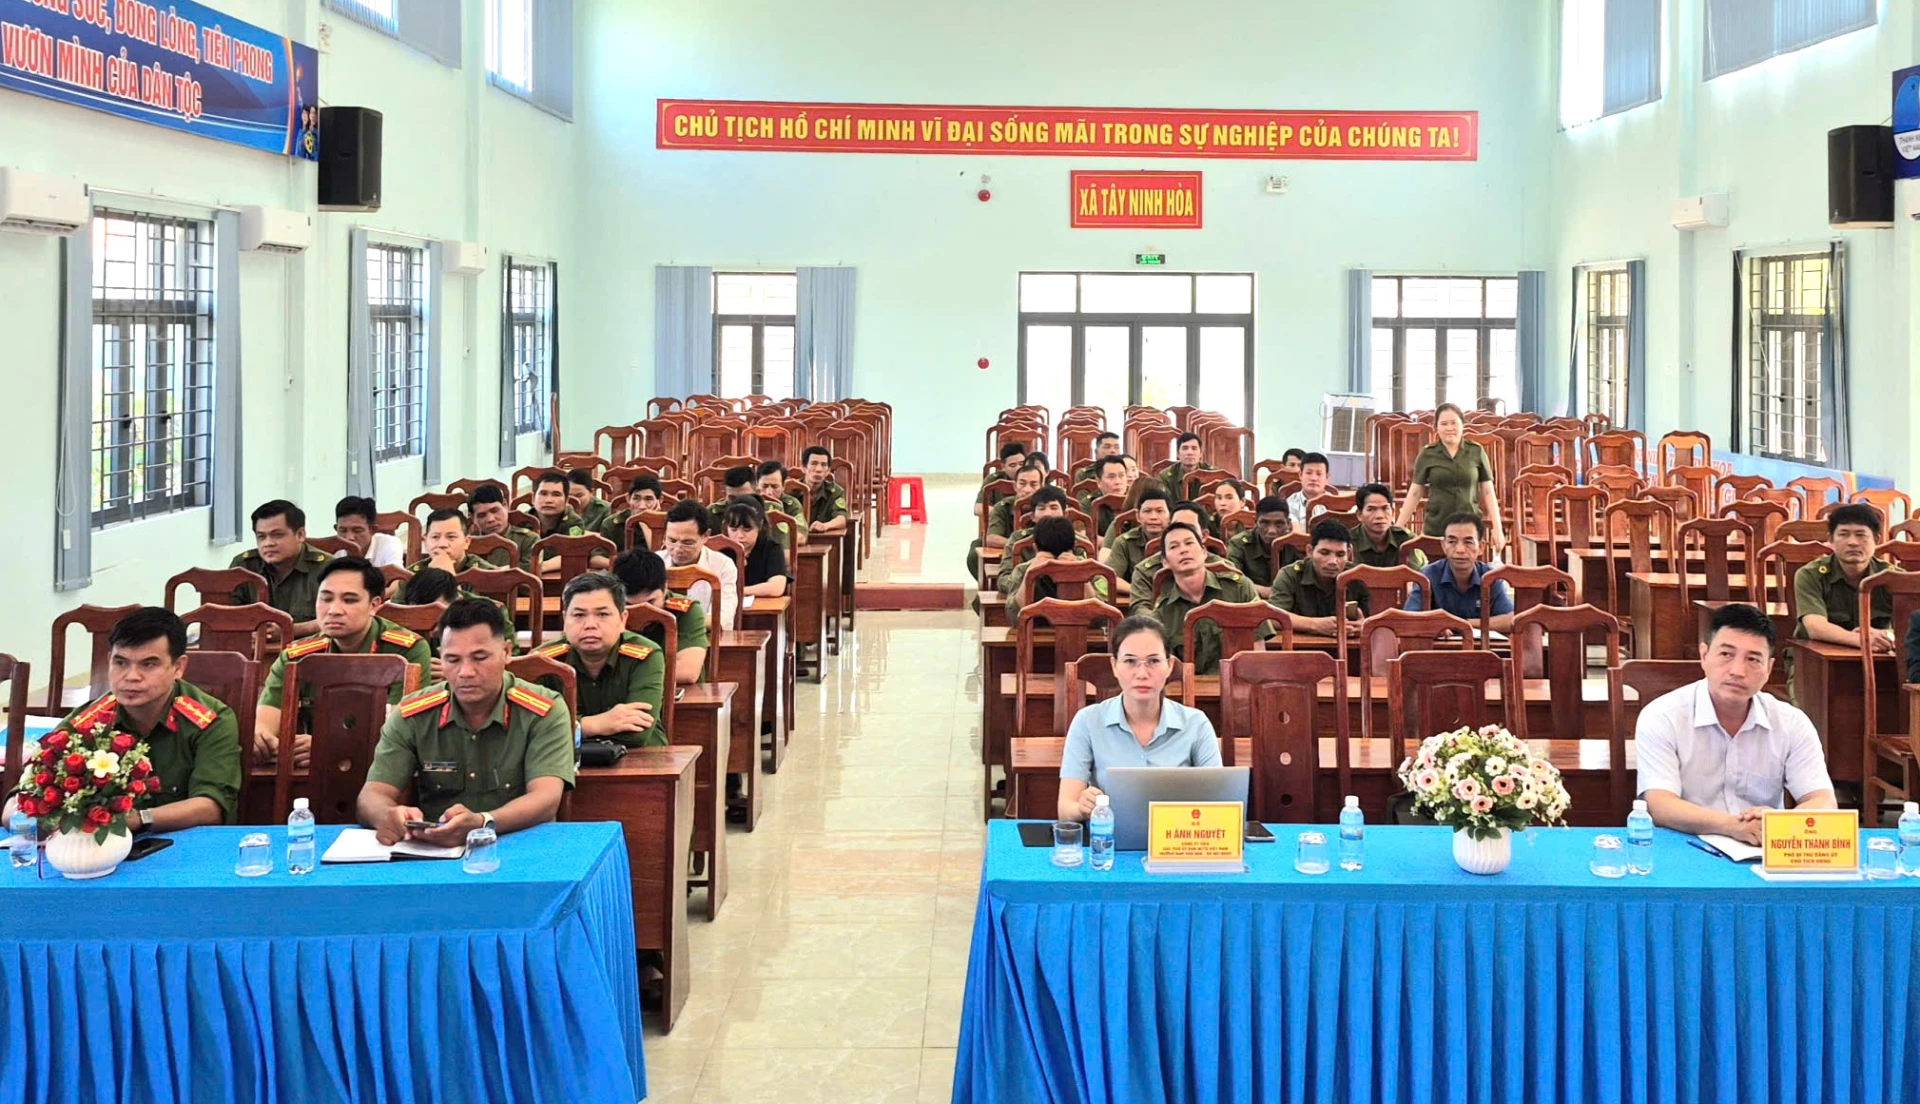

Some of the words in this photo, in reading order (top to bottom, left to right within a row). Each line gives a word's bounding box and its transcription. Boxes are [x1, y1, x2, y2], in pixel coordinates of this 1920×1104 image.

[1, 21, 54, 78] VƯƠN
[57, 35, 104, 90] MÌNH
[107, 46, 140, 99] CỦA
[141, 62, 173, 110] DÂN
[175, 72, 202, 122] TỘC
[160, 6, 200, 64] LÒNG,
[233, 39, 273, 84] PHONG
[674, 109, 718, 137] CHỦ
[724, 115, 774, 143] TỊCH
[780, 111, 808, 139] HỒ
[814, 114, 851, 140] CHÍ
[857, 119, 915, 141] MINH
[921, 116, 943, 142] VĨ
[947, 120, 984, 147] ĐẠI
[989, 114, 1049, 143] SỐNG
[1055, 118, 1096, 144] MÃI
[1102, 123, 1173, 145] TRONG
[1178, 123, 1208, 150] SỰ
[1213, 121, 1293, 151] NGHIỆP
[1299, 119, 1342, 147] CỦA
[1347, 122, 1422, 148] CHÚNG
[1427, 127, 1460, 148] TA!
[1079, 183, 1098, 216] XÃ
[1101, 183, 1126, 216] TÂY
[1128, 188, 1163, 216] NINH
[1166, 182, 1193, 217] HÒA
